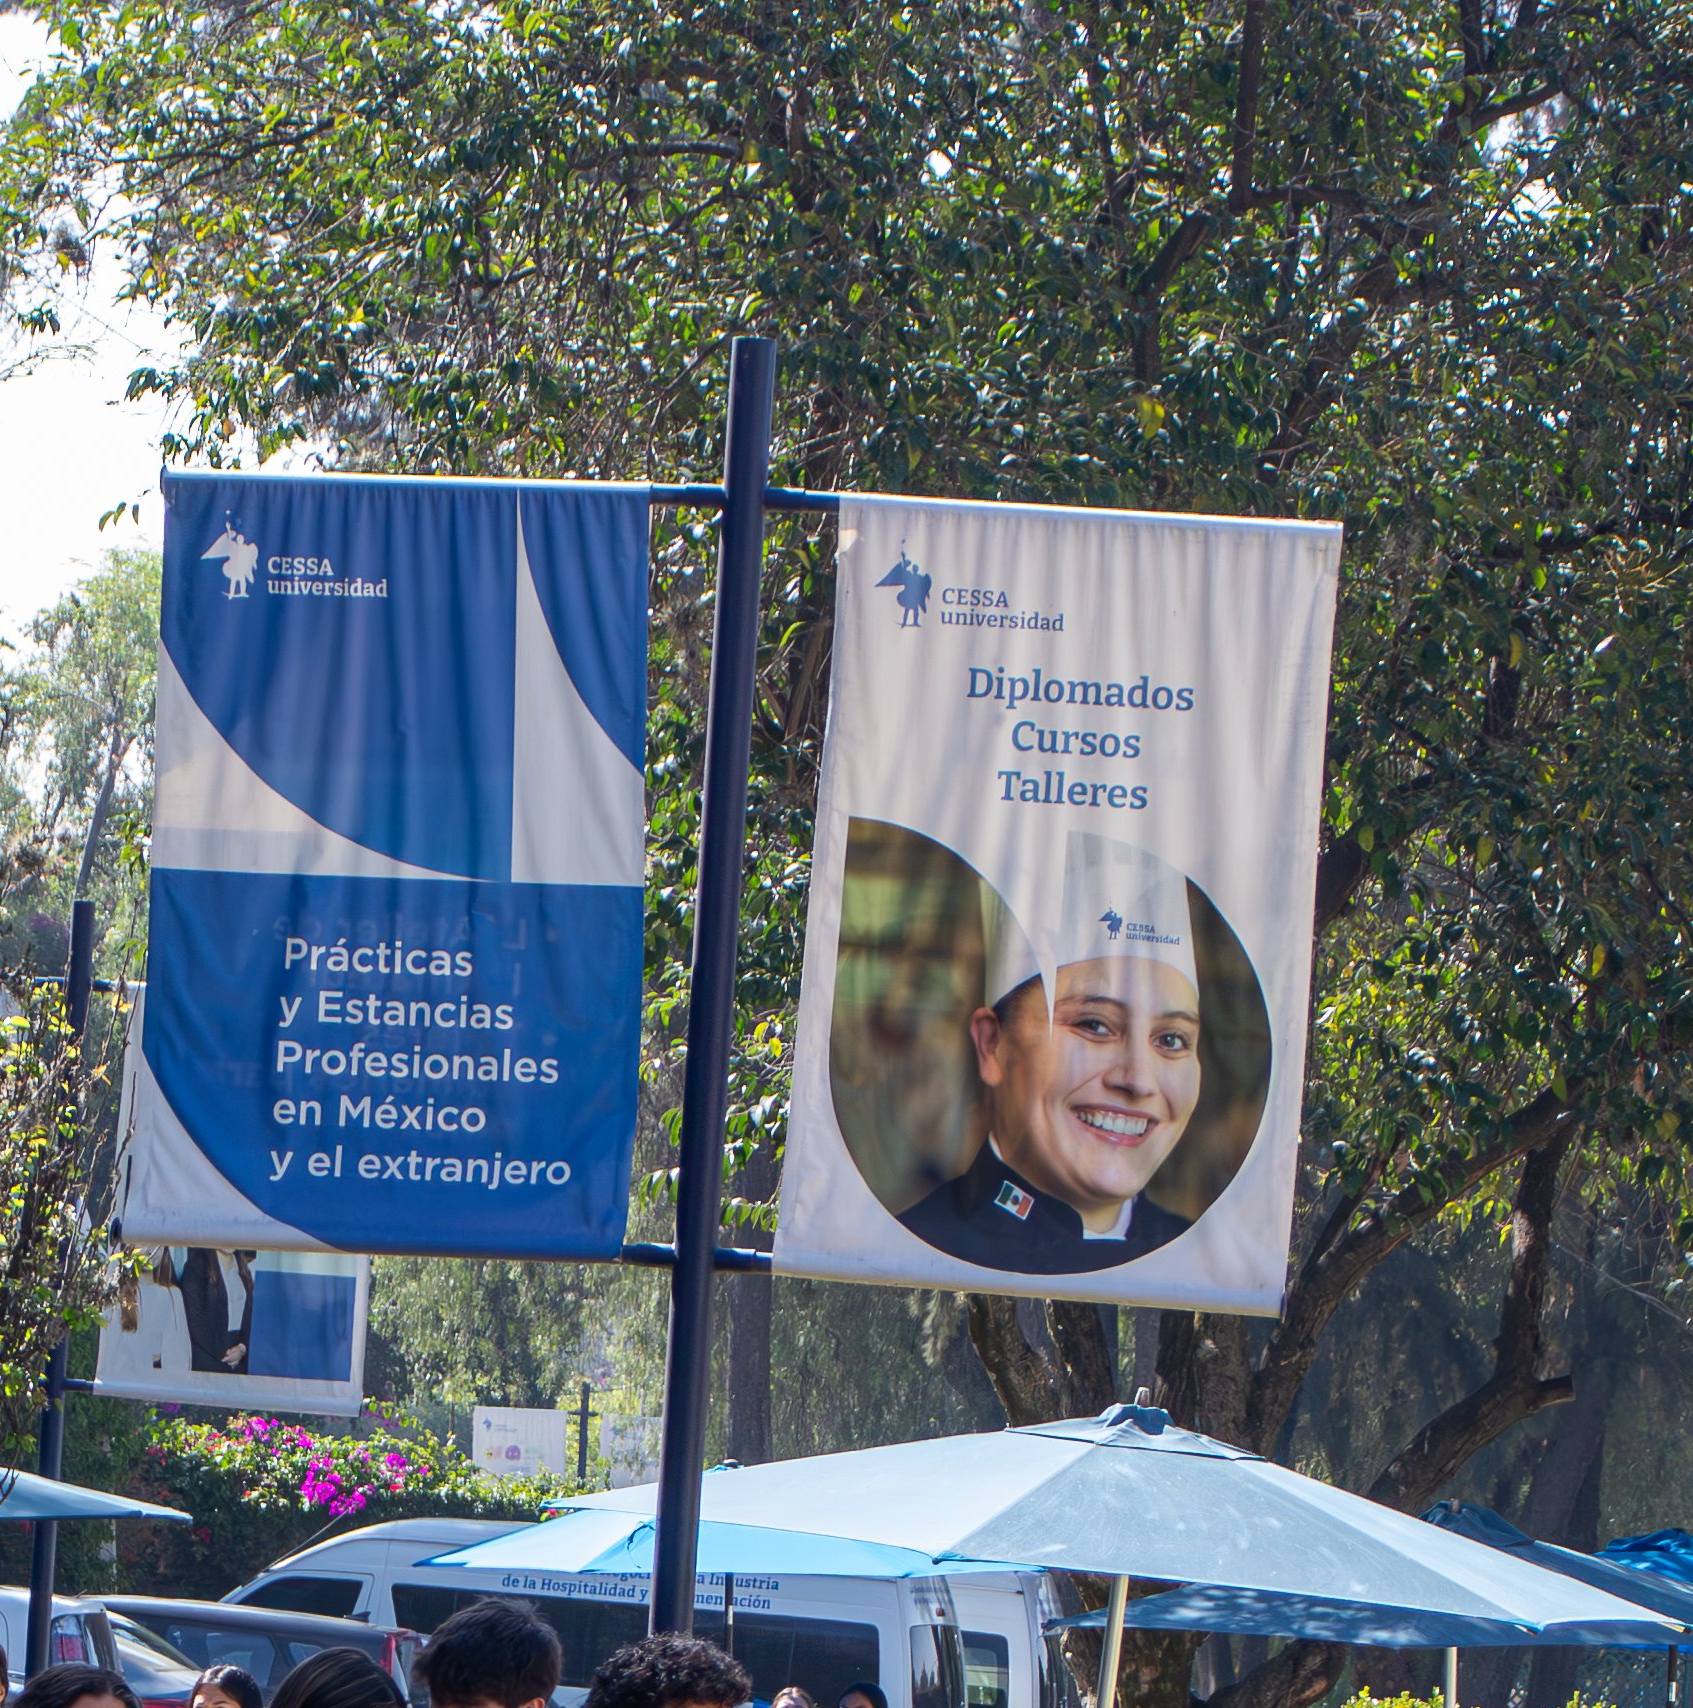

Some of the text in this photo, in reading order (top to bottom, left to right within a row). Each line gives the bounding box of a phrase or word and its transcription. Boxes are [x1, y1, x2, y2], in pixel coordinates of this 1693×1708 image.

[267, 556, 334, 576] CESSA
[267, 576, 388, 598] universidad
[941, 587, 1010, 608] CESSA
[940, 608, 1065, 632] universidad
[966, 666, 1195, 712] Diplomados
[1011, 720, 1141, 759] Cursos
[997, 770, 1149, 810] Talleres
[284, 937, 473, 977] Prácticas
[278, 990, 514, 1030] y Estancias
[276, 1040, 559, 1084] Profesionales
[272, 1094, 487, 1133] en México
[269, 1144, 572, 1190] y el extranjero
[501, 1574, 519, 1588] de
[523, 1574, 537, 1590] la
[540, 1577, 636, 1598] Hospitalidad
[639, 1588, 649, 1601] y
[709, 1573, 779, 1591] Inustria
